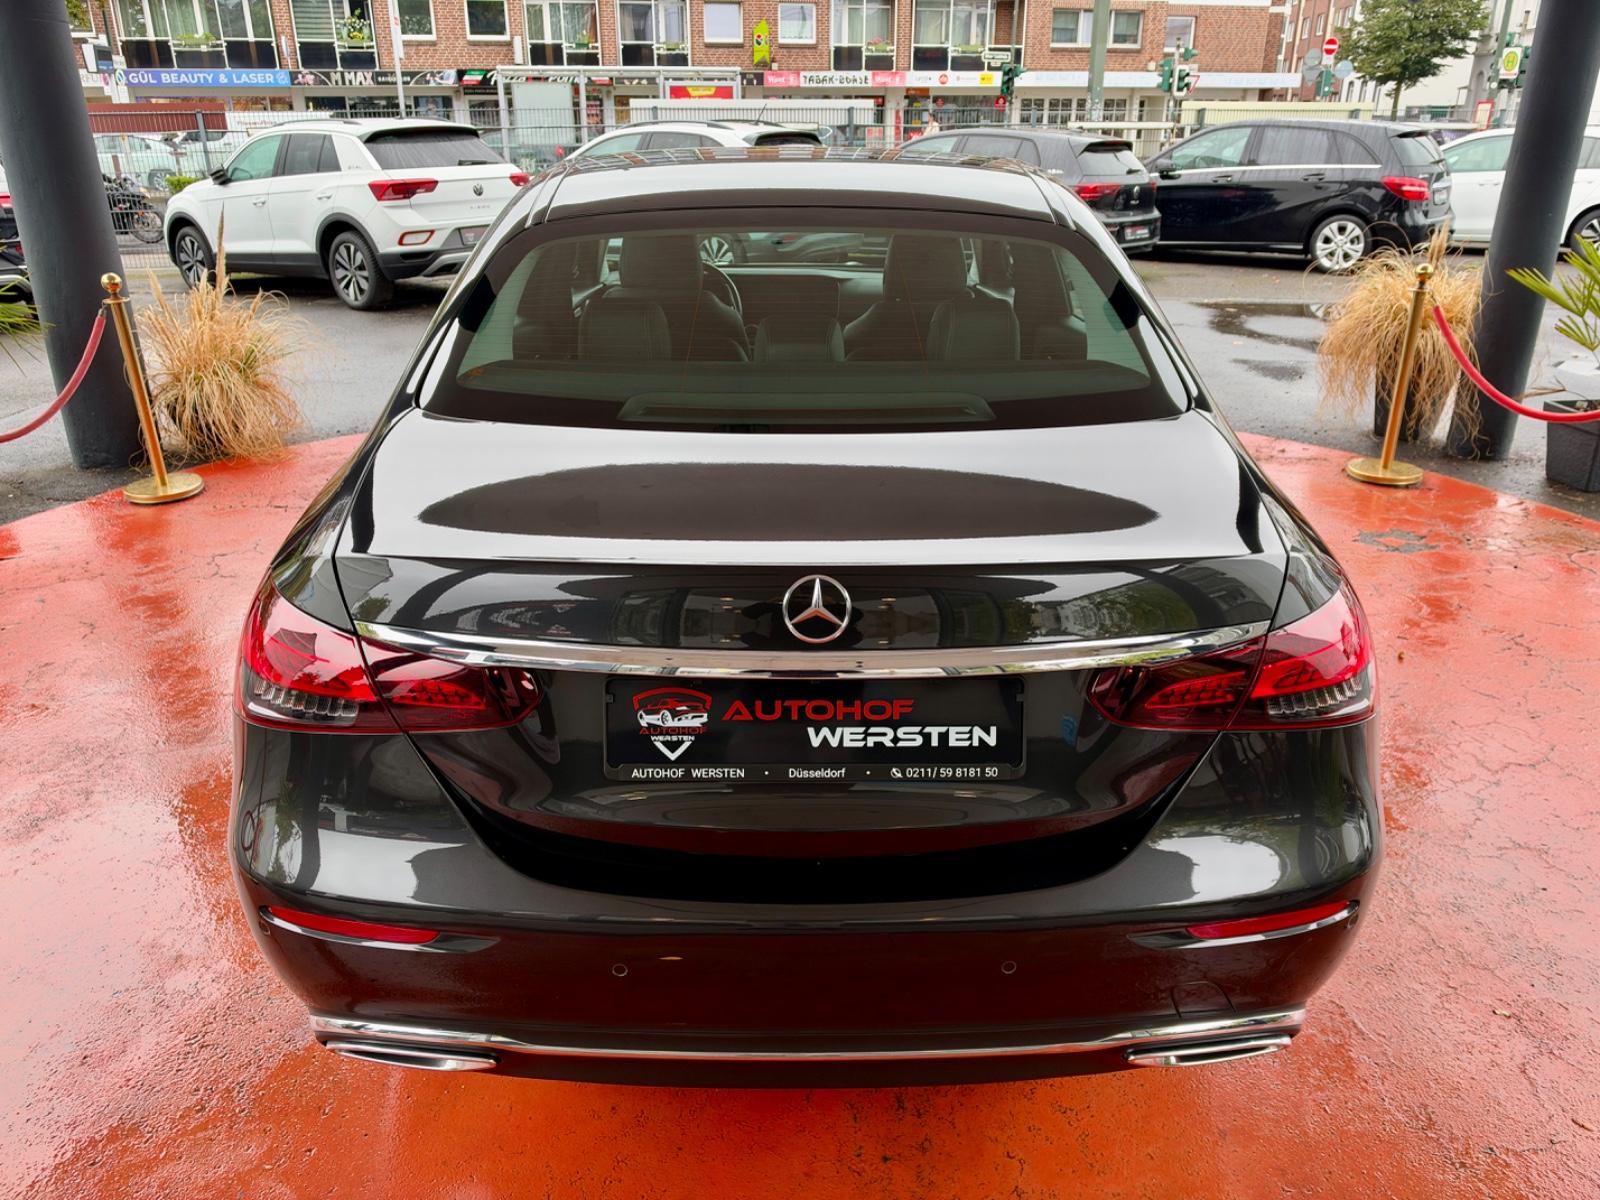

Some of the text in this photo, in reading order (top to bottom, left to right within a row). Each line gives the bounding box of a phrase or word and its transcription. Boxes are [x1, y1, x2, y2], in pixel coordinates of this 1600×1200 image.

[129, 71, 274, 84] GÜL BEAUTY & LASER
[344, 72, 375, 85] MAX
[722, 699, 914, 721] AUTOHOF
[640, 727, 708, 735] AUTOHOF
[807, 726, 997, 748] WERSTEN
[631, 768, 745, 779] AUTOHOF WERSTEN
[788, 767, 846, 778] Düsseldorf
[939, 767, 953, 778] 59
[955, 767, 981, 778] 8181
[985, 767, 998, 778] 50
